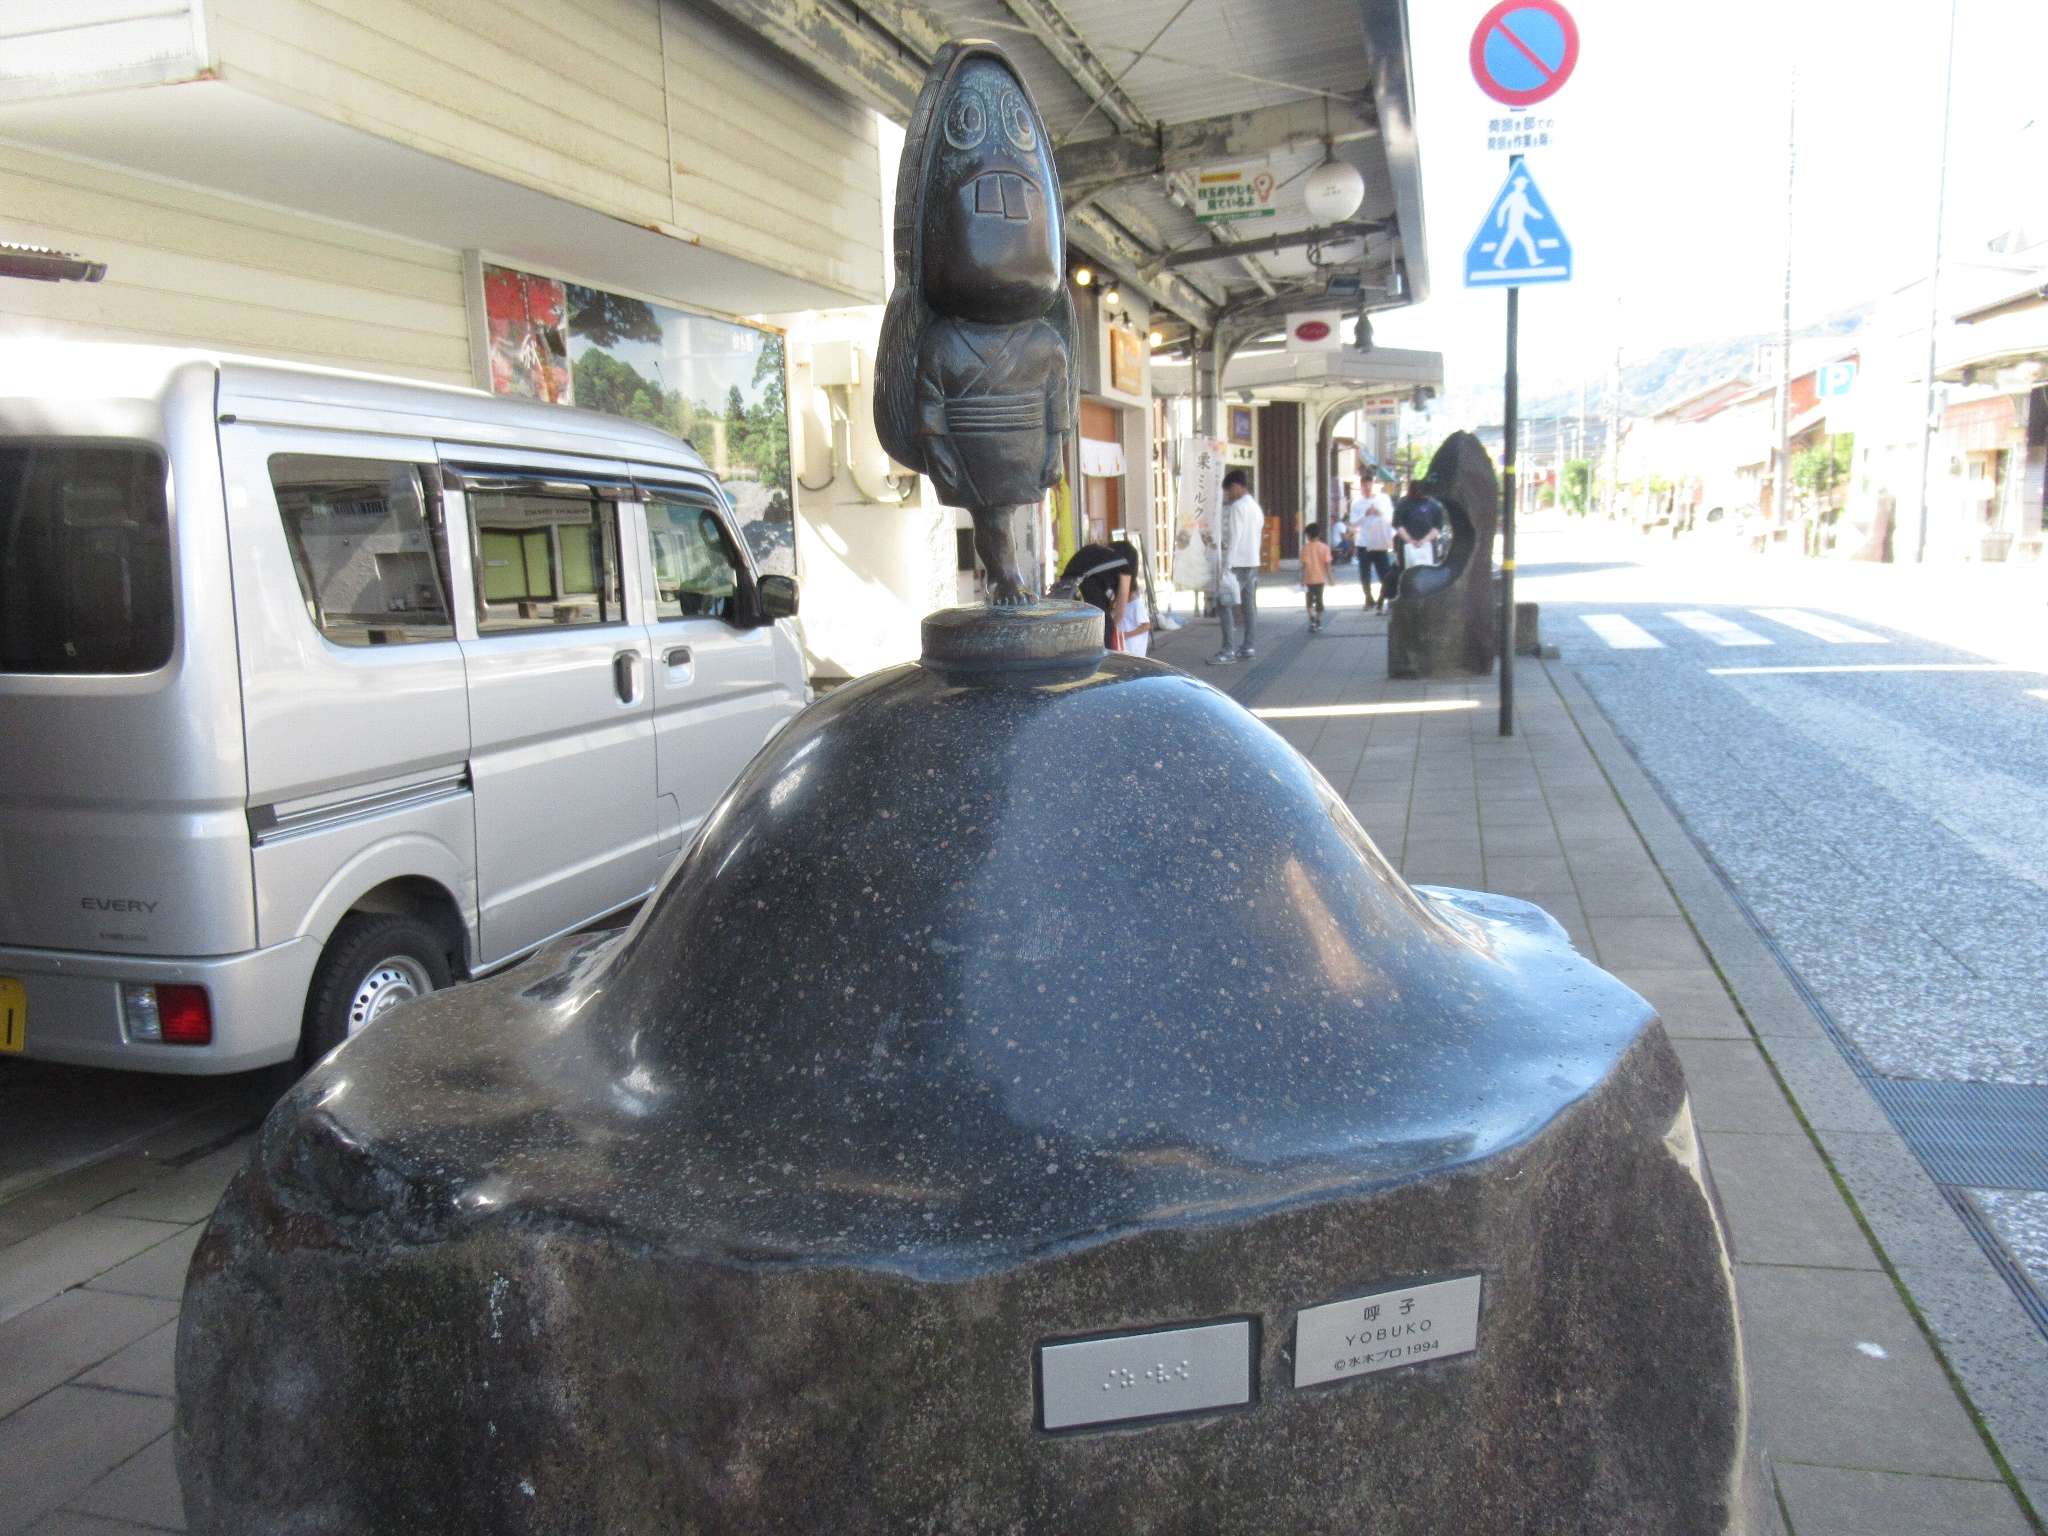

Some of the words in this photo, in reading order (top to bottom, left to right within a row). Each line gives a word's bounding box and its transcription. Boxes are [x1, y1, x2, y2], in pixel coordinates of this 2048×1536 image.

[1825, 366, 1849, 397] P
[80, 897, 158, 913] EVERY
[1345, 1319, 1432, 1347] YOBUKO
[1406, 1340, 1440, 1356] 1994
